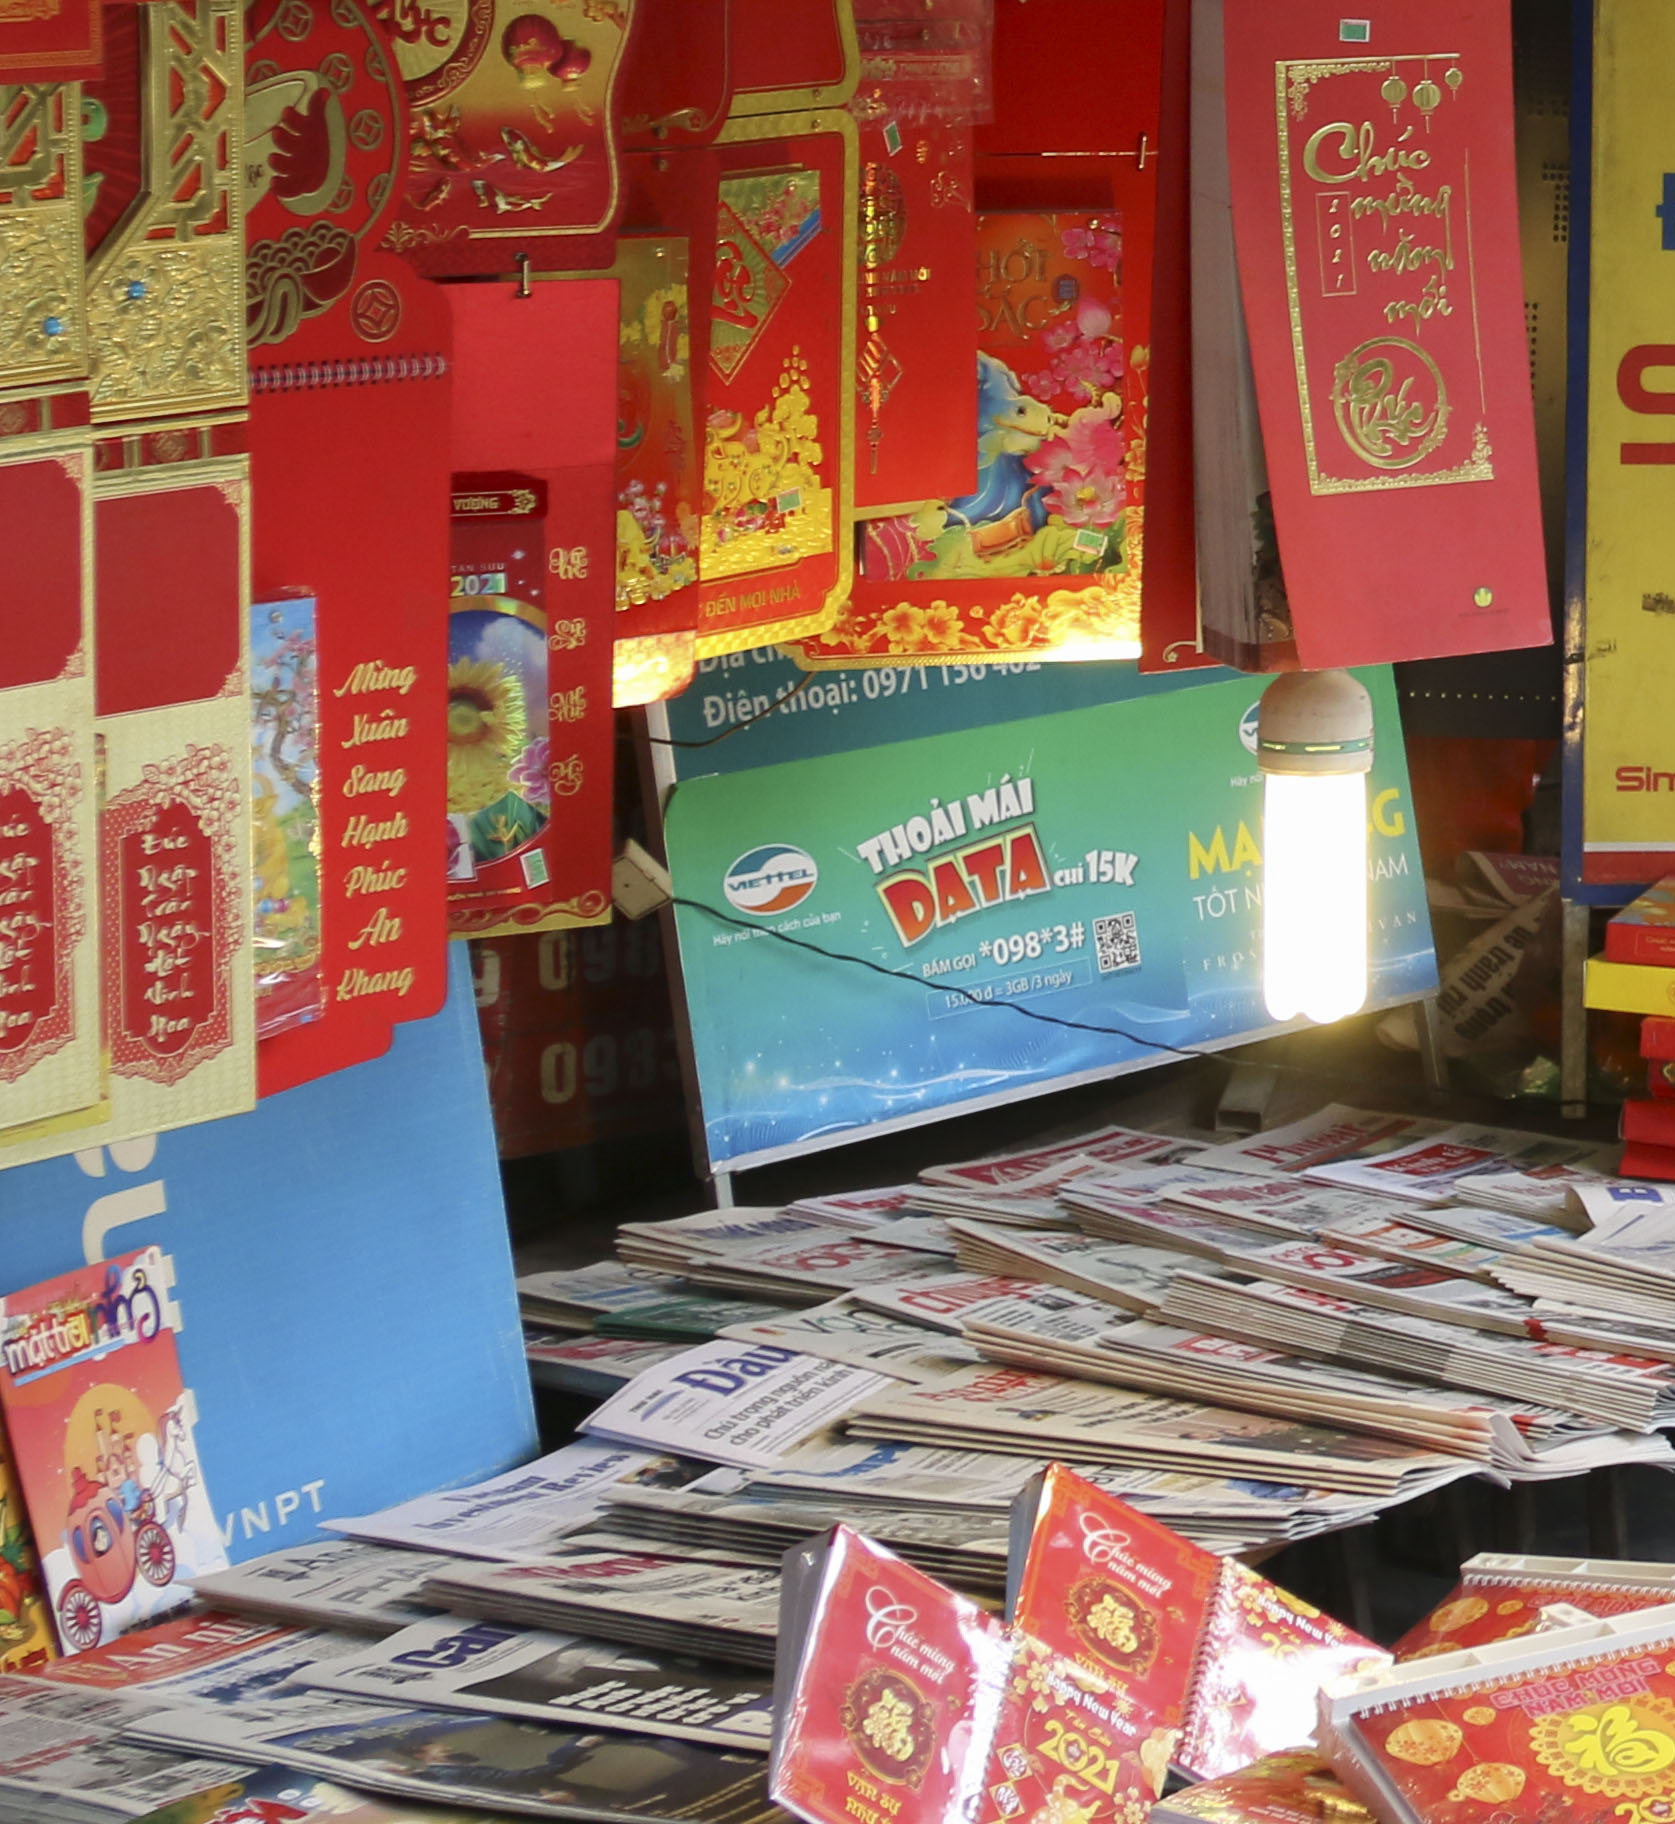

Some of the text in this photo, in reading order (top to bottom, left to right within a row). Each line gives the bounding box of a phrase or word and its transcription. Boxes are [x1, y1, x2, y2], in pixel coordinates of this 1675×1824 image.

[1302, 121, 1432, 184] Chúc
[450, 571, 508, 597] 2021
[702, 691, 771, 731] Điện
[862, 662, 929, 702] 0971
[342, 762, 408, 802] Sang
[856, 774, 1036, 875] THOẢI MÁI
[1188, 787, 1406, 881] MẠG
[873, 821, 1052, 948] DATA
[1085, 849, 1140, 887] 15K
[347, 907, 404, 950] An
[335, 960, 416, 1003] Khang
[218, 1478, 326, 1549] VNPT
[1079, 1511, 1135, 1568] Chúc
[864, 1584, 922, 1653] Chúc
[1256, 1592, 1325, 1640] Happy New
[1046, 1671, 1138, 1738] Happy New Year
[1036, 1719, 1121, 1796] 2021
